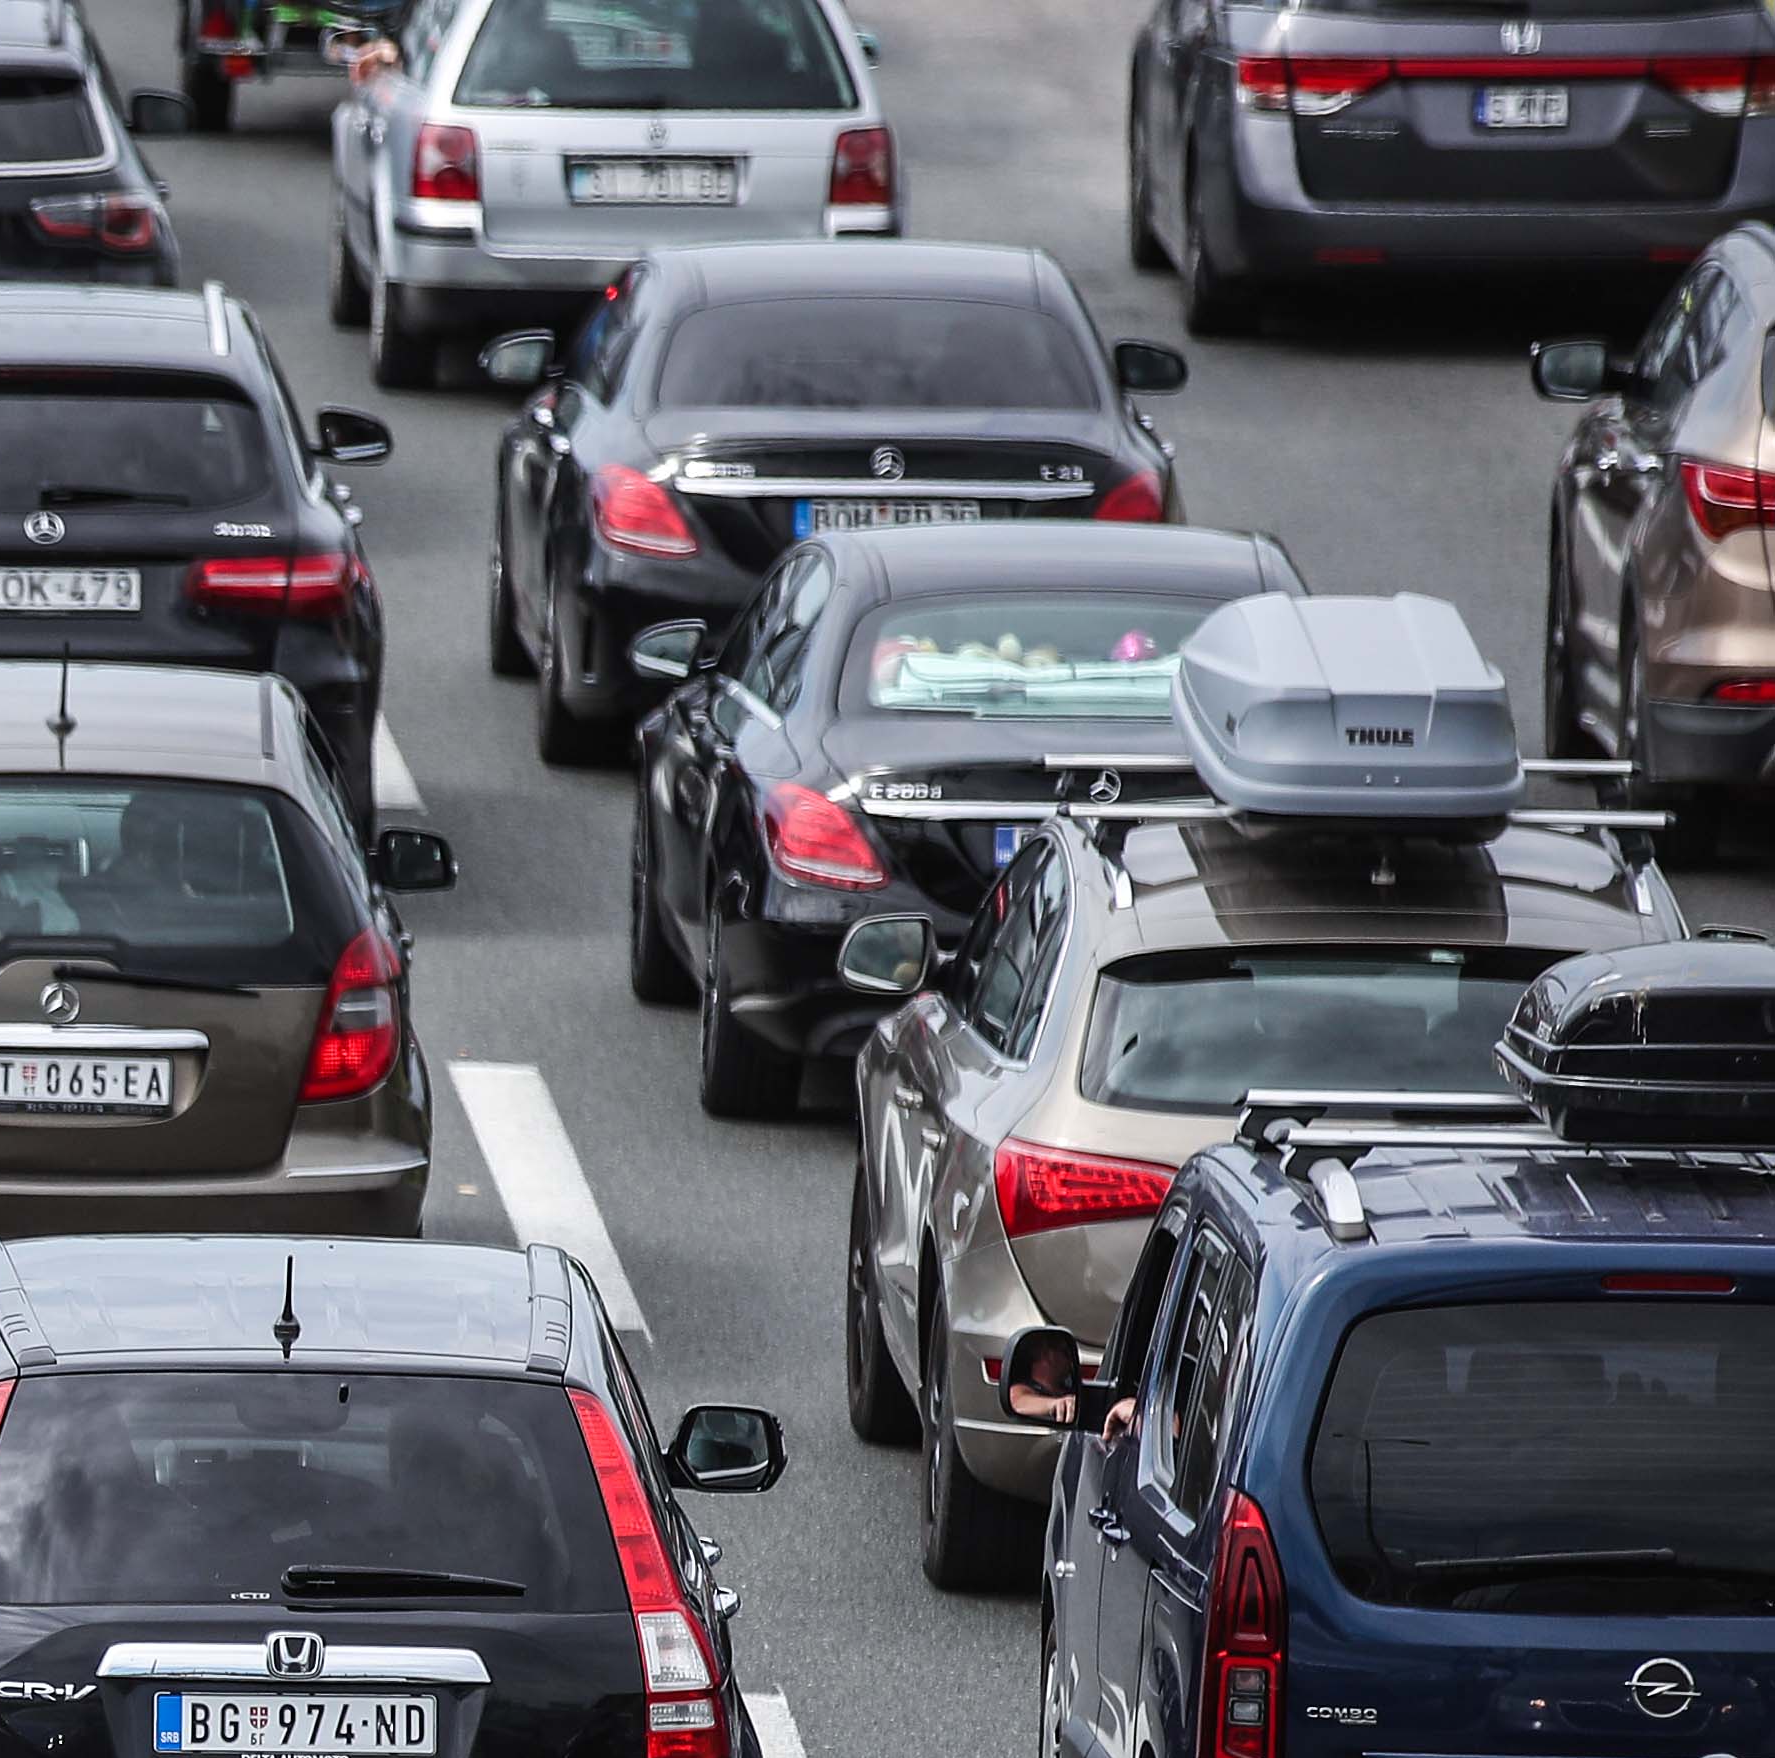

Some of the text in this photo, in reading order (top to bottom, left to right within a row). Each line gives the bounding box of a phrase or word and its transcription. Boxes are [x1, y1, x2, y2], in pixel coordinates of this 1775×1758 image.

[1345, 727, 1415, 747] THULE
[1306, 1706, 1378, 1719] COMBO
[190, 1702, 240, 1744] BG
[160, 1731, 180, 1743] SRB
